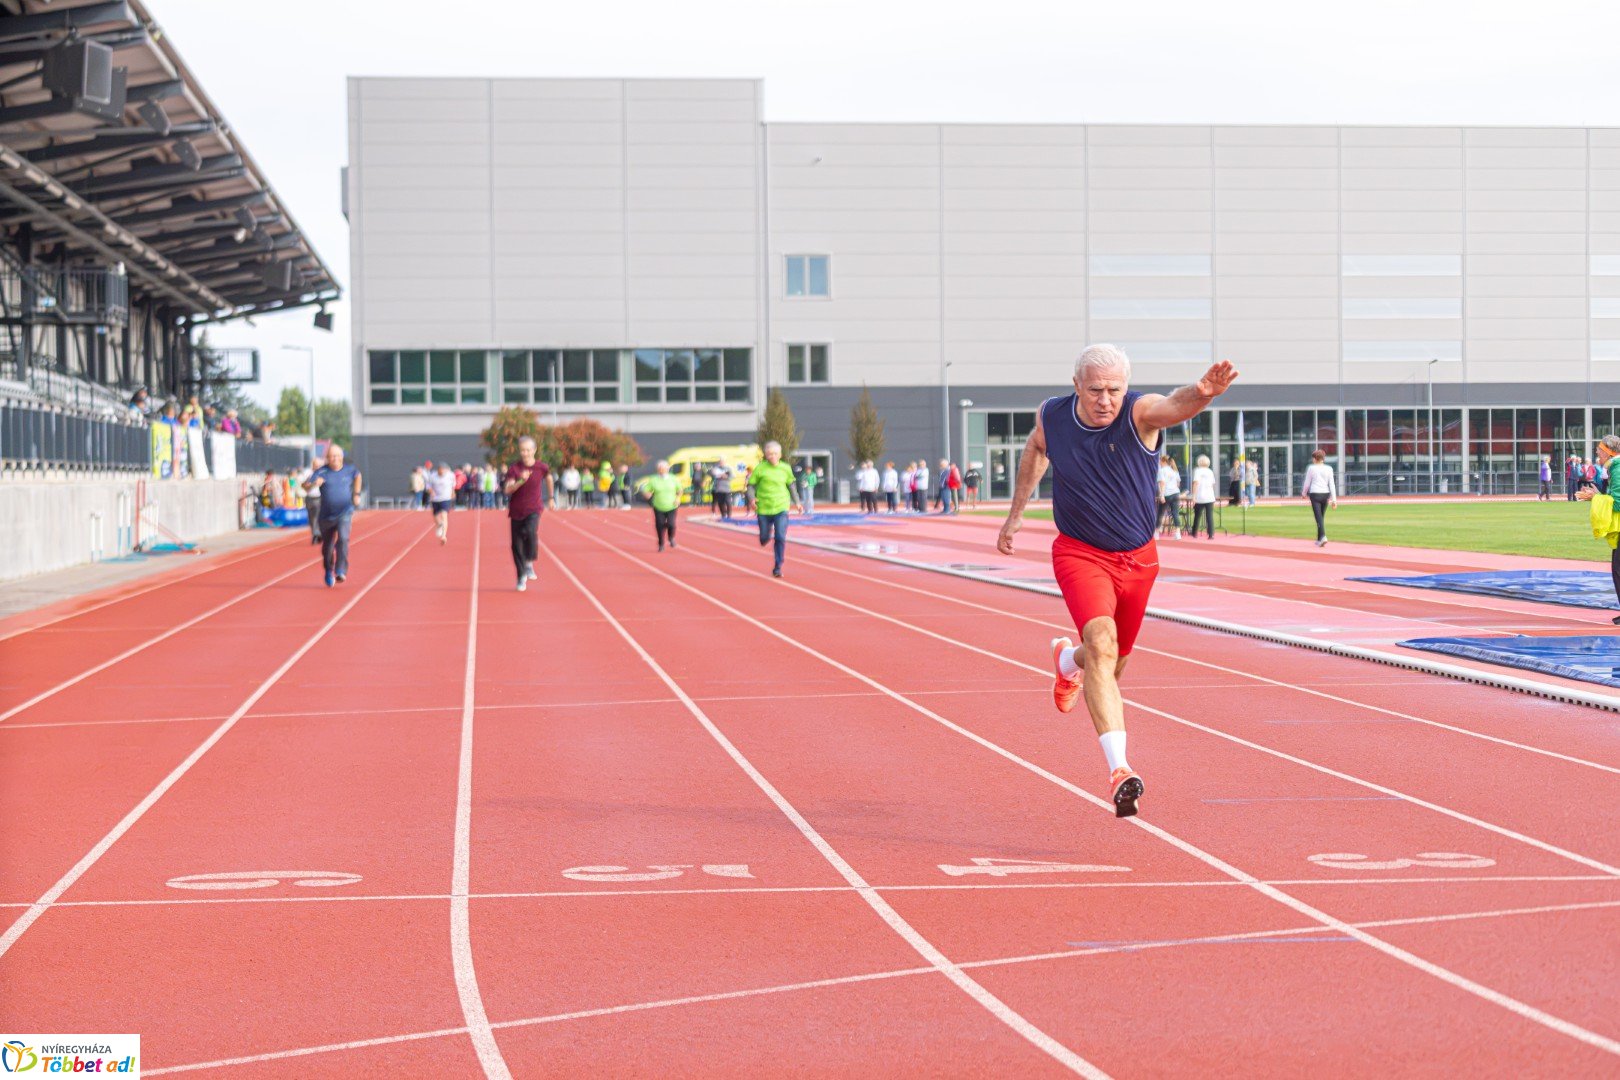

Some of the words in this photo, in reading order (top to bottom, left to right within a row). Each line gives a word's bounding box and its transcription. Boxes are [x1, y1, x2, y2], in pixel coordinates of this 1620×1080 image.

[937, 857, 1132, 876] 4
[1307, 852, 1496, 870] 3
[166, 870, 363, 890] 6
[562, 864, 756, 882] 5
